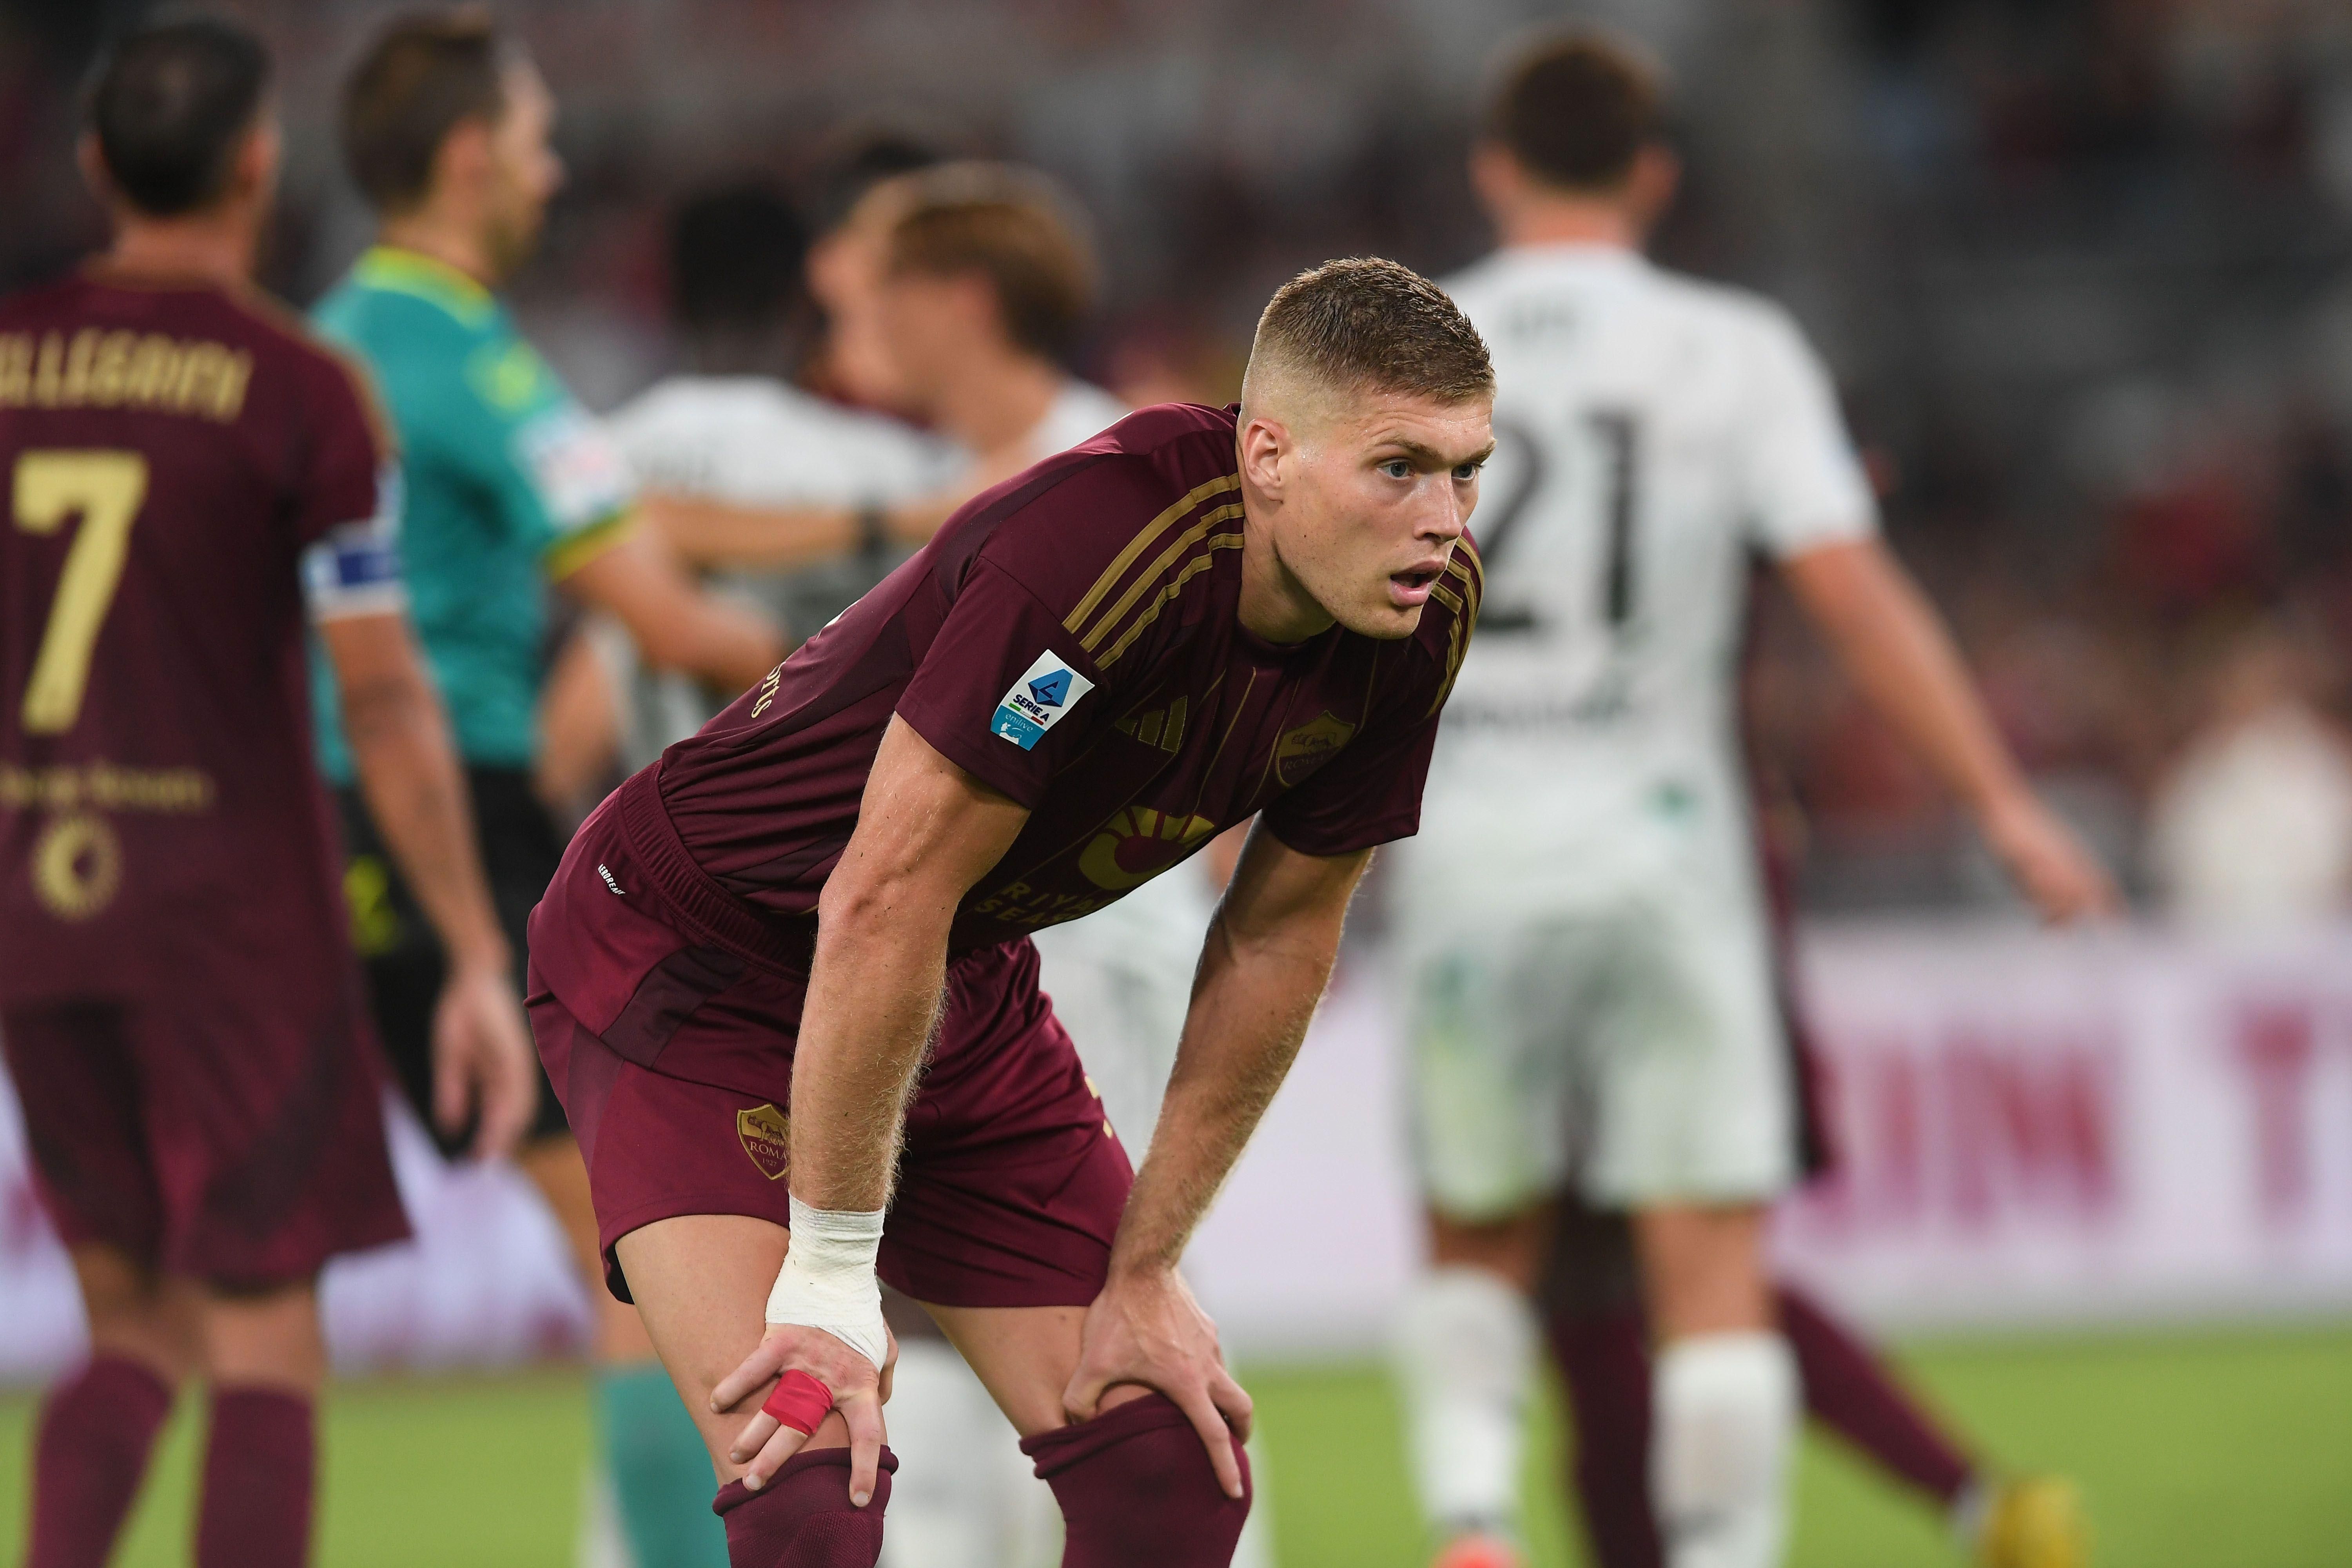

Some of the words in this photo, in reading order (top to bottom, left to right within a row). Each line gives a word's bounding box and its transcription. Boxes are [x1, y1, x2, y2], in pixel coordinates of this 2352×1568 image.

[1476, 400, 1641, 634] 21
[13, 449, 150, 734] 7
[1013, 694, 1043, 717] SERIE
[1040, 712, 1050, 722] A
[1005, 713, 1033, 732] enilive
[750, 1141, 787, 1160] ROMA
[763, 1158, 777, 1167] 1927
